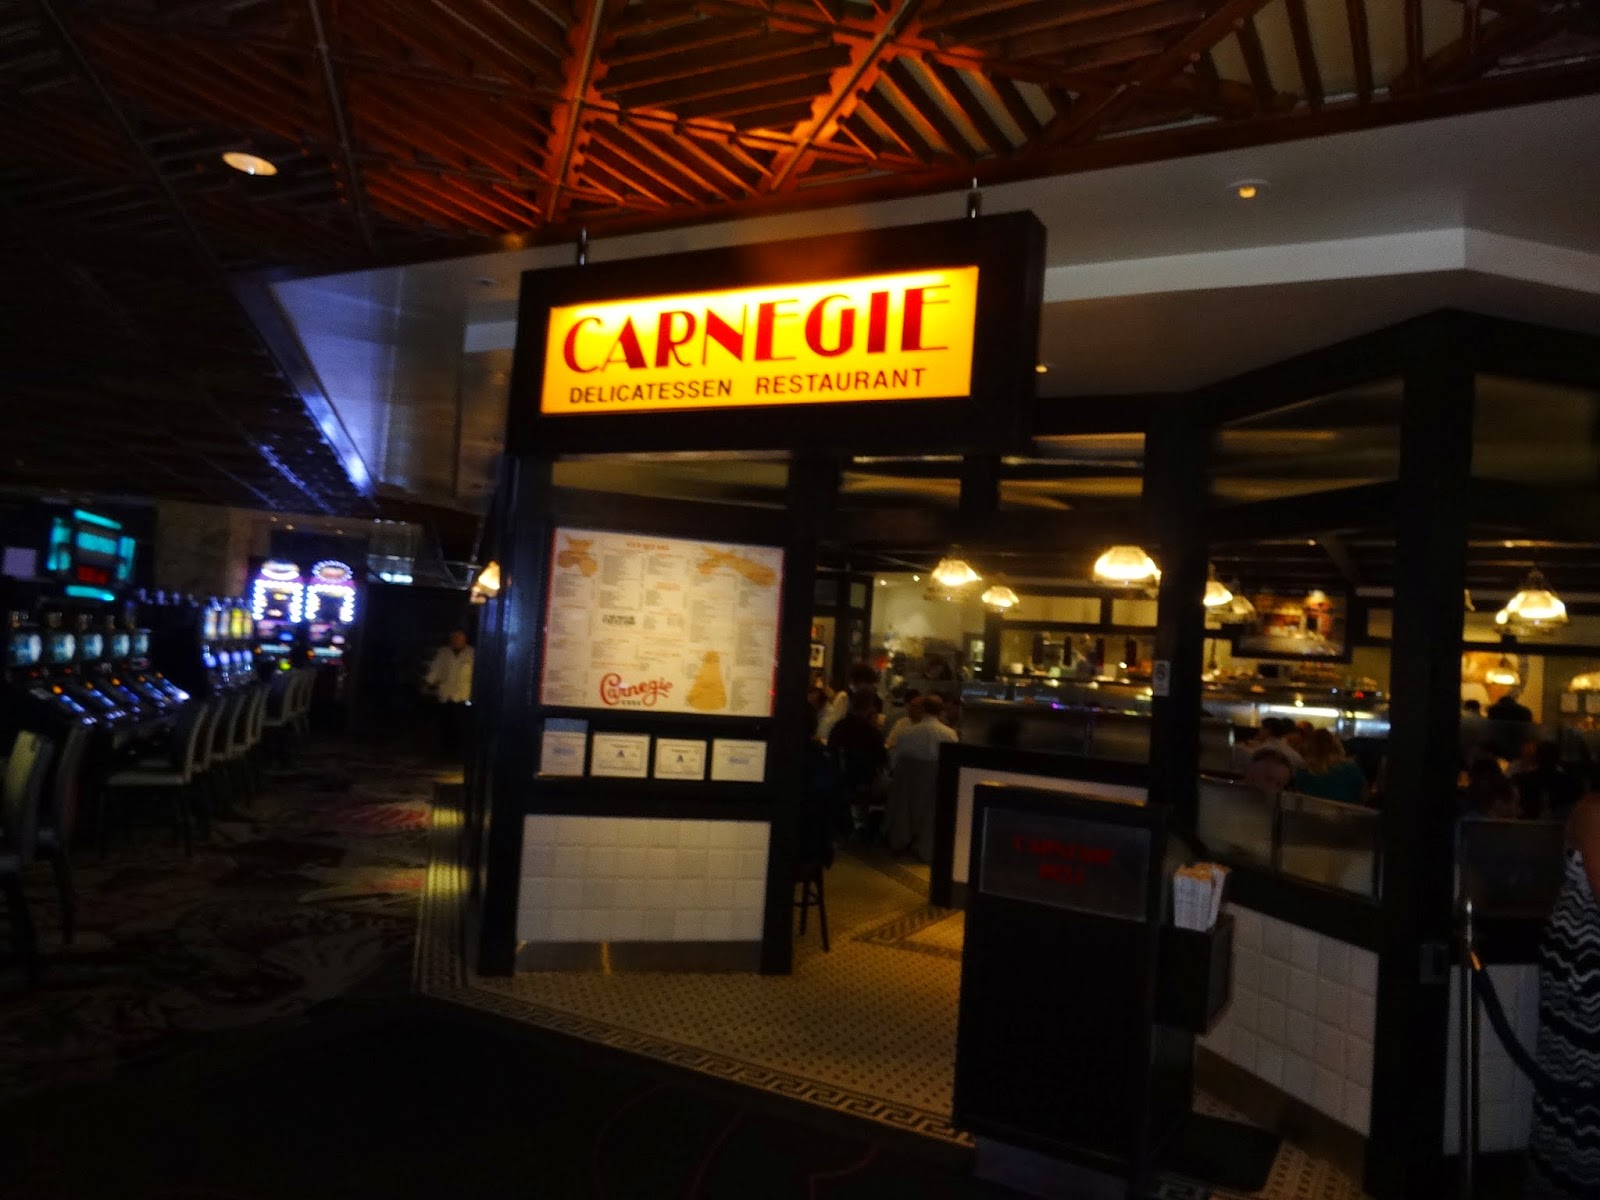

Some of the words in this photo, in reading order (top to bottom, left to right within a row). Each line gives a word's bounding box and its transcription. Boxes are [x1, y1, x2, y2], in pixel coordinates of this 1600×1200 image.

[563, 285, 950, 374] CARNEGIE
[569, 379, 732, 404] DELICATESSEN
[755, 368, 926, 395] RESTAURANT
[600, 672, 673, 707] Carnegie
